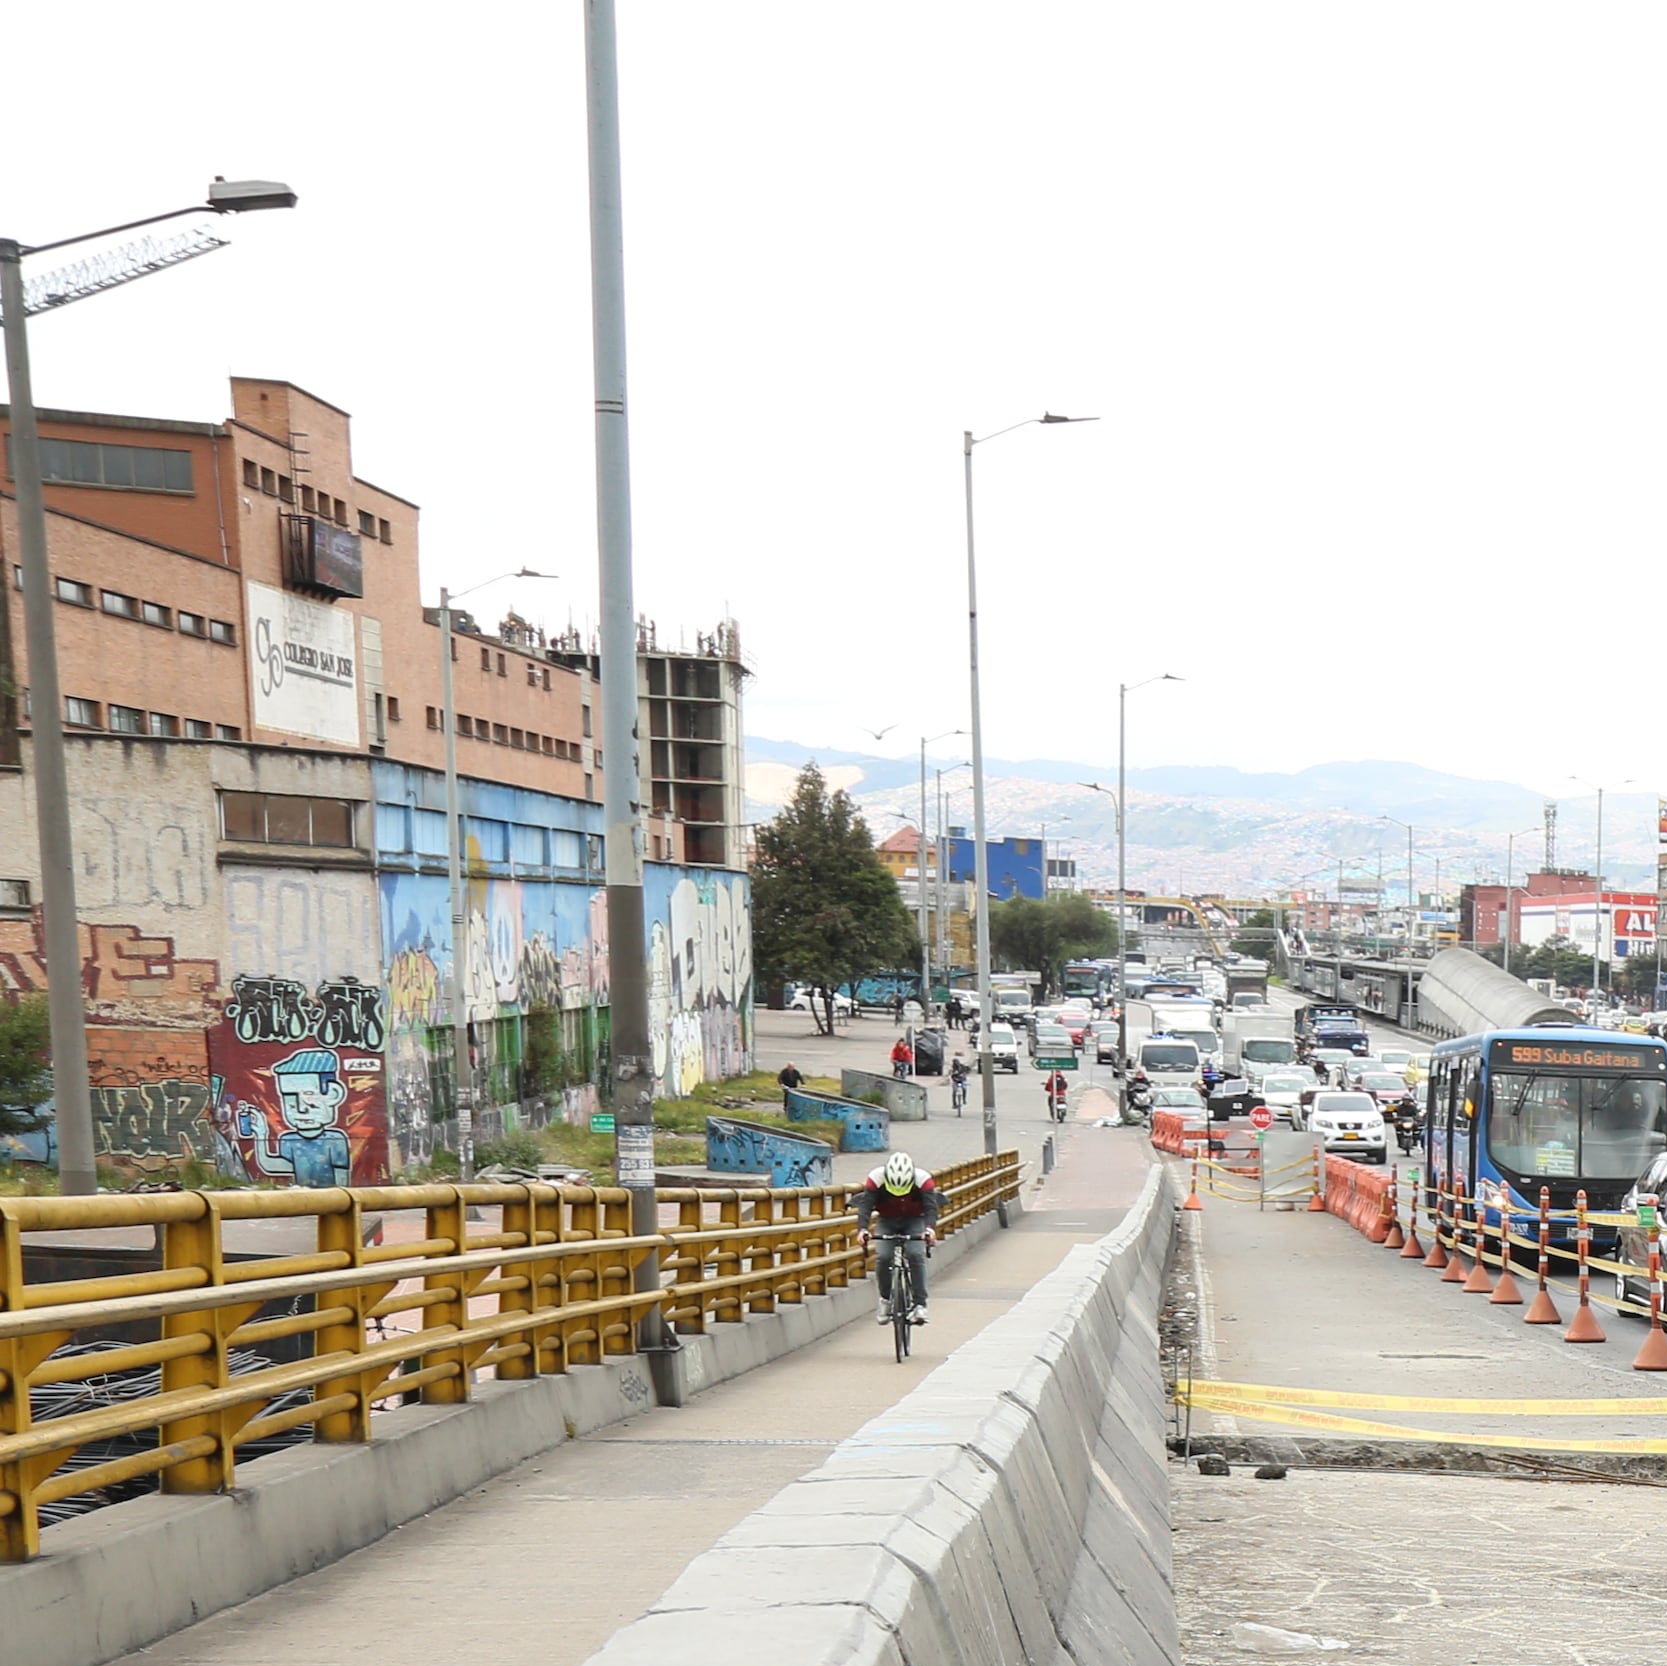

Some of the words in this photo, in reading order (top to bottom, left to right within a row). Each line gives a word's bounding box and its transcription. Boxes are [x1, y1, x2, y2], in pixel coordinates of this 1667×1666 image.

[284, 642, 318, 669] COLEGIO
[320, 651, 335, 672] SAN
[1512, 1046, 1541, 1063] 599
[1544, 1048, 1582, 1065] Suba
[1583, 1050, 1640, 1068] Gaitana
[1251, 1113, 1271, 1123] PARE
